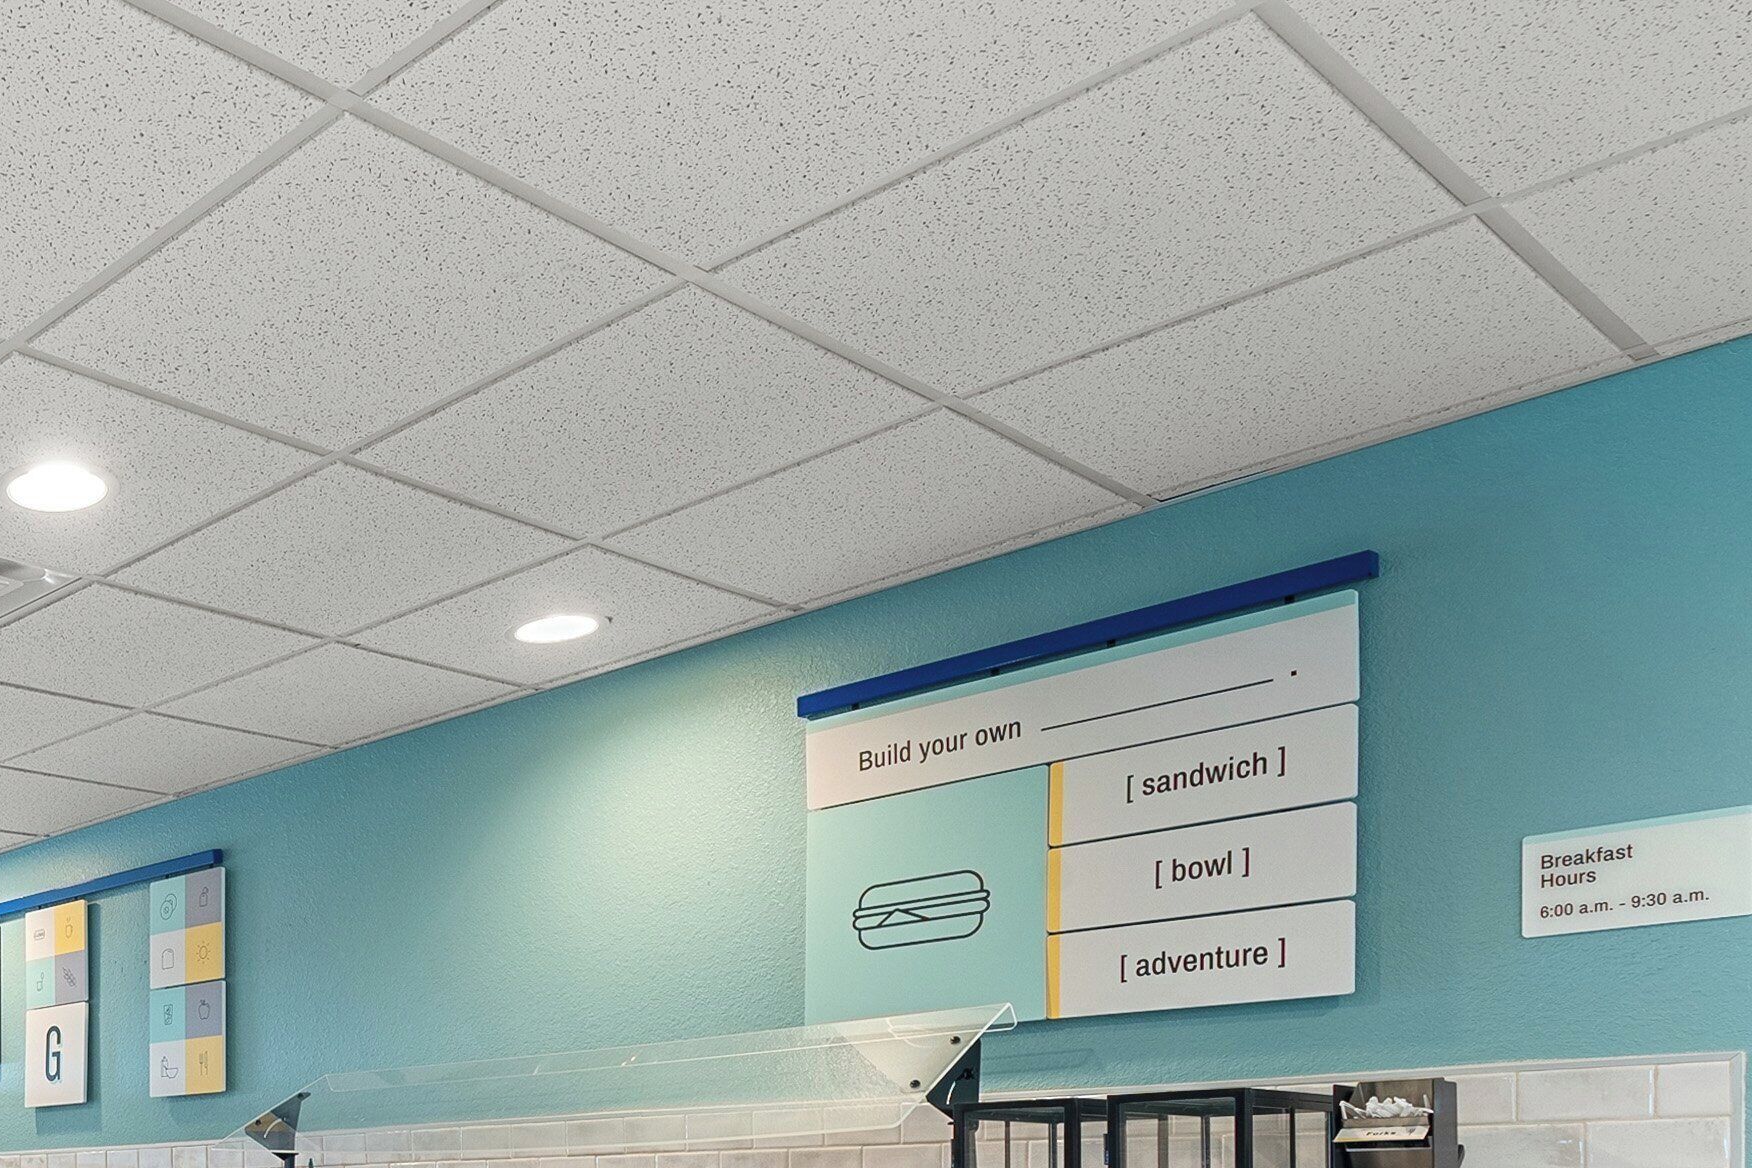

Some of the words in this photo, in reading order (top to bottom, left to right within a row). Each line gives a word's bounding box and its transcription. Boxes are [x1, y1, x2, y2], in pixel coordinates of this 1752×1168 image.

[858, 740, 911, 771] Build
[919, 730, 968, 764] your
[975, 719, 1022, 746] own
[1540, 843, 1634, 870] Breakfast
[1540, 870, 1597, 889] Hours
[1539, 902, 1574, 919] 6:00
[1579, 900, 1614, 915] a.m.
[1630, 892, 1667, 909] 9:30
[1672, 889, 1710, 904] a.m.
[45, 1025, 62, 1083] G
